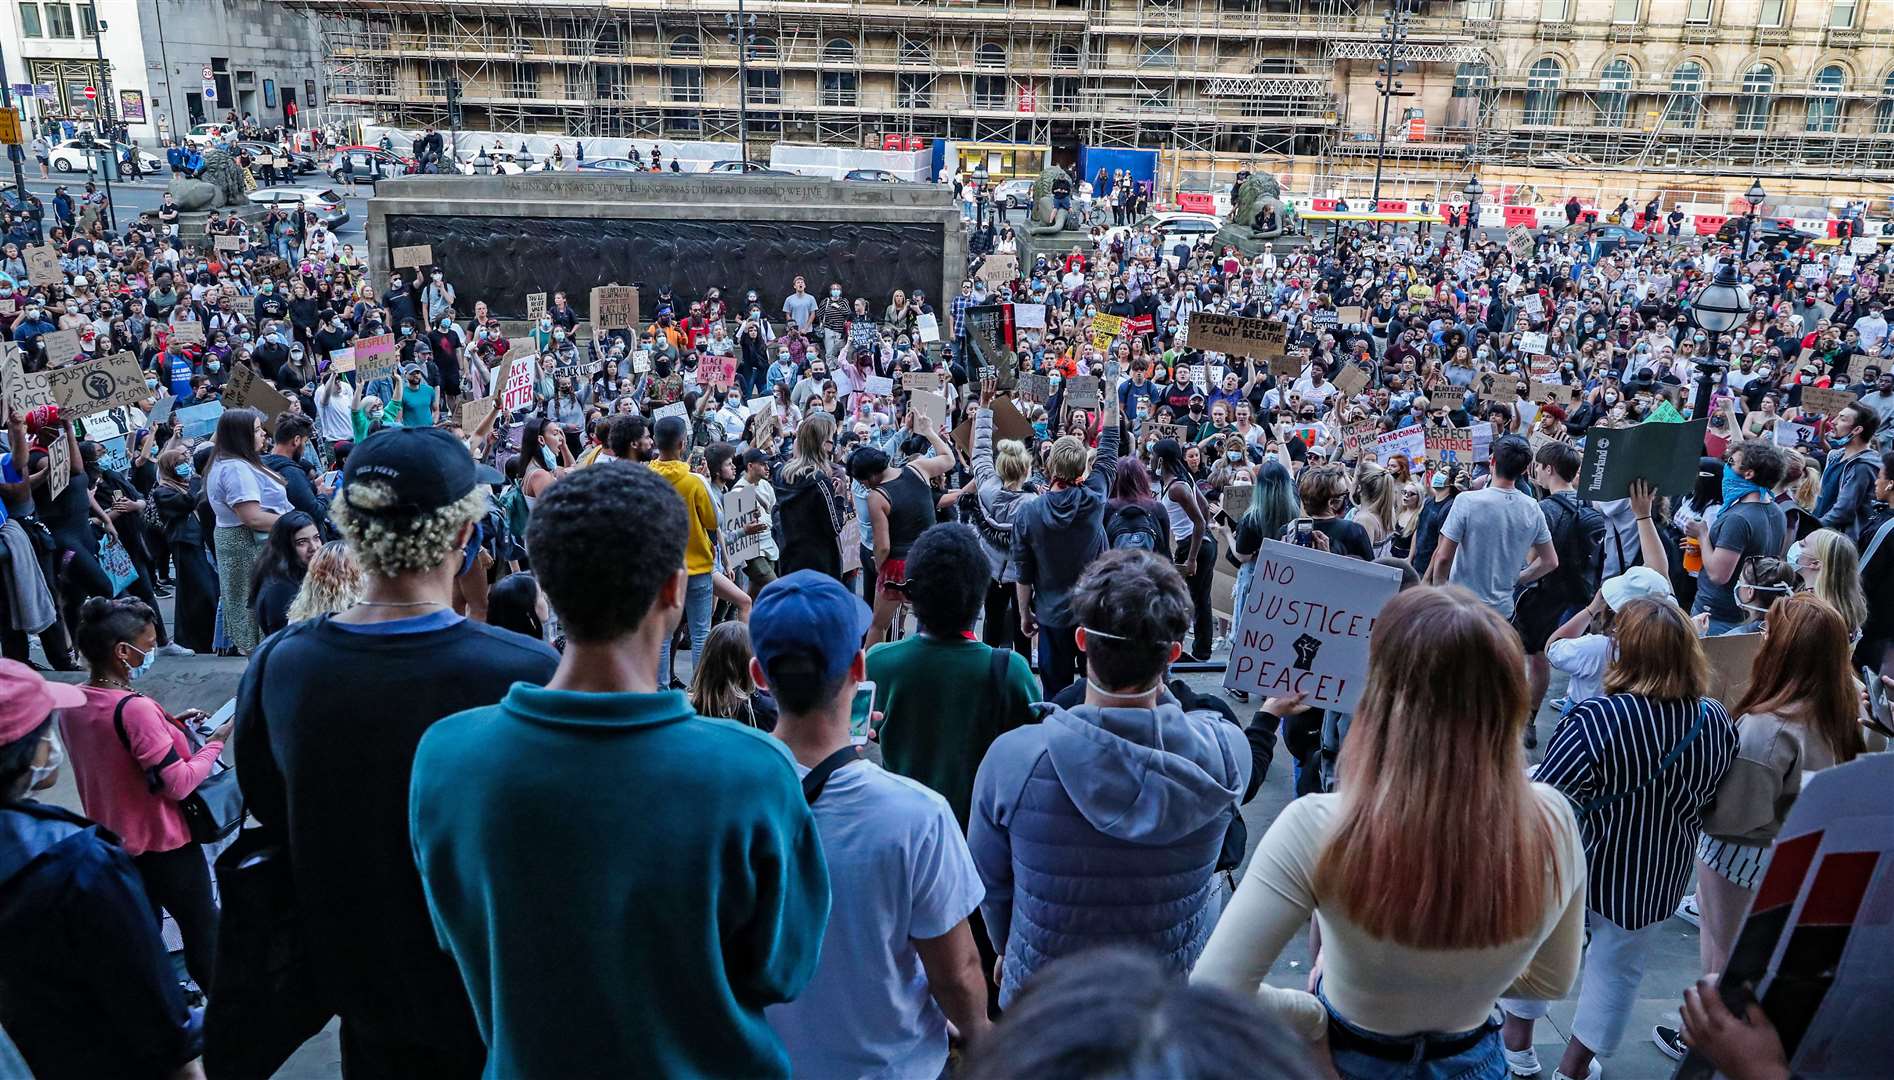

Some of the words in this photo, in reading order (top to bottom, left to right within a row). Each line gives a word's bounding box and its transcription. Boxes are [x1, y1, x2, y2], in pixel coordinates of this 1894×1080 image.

[600, 313, 628, 326] MATTER
[1192, 314, 1234, 328] FREEDOM
[1238, 318, 1282, 332] FREEDOM
[1242, 329, 1284, 343] BREATHE
[110, 356, 130, 369] FOR
[511, 361, 528, 377] ACK
[509, 373, 530, 390] IVES
[116, 387, 147, 402] FLOYD
[505, 385, 532, 410] ATTER
[89, 415, 111, 427] PEACE
[1341, 427, 1355, 437] NO
[1425, 428, 1471, 439] RESPECT
[1344, 436, 1358, 450] NO
[1425, 438, 1472, 451] EXISTENCE
[1440, 449, 1456, 462] OR
[1427, 459, 1471, 472] EXPCT
[1588, 449, 1608, 491] Timberland
[738, 498, 742, 512] I
[1263, 559, 1294, 584] NO
[1249, 592, 1376, 639] JUSTICE!
[1244, 629, 1273, 652] NO
[1235, 656, 1346, 704] PEACE!
